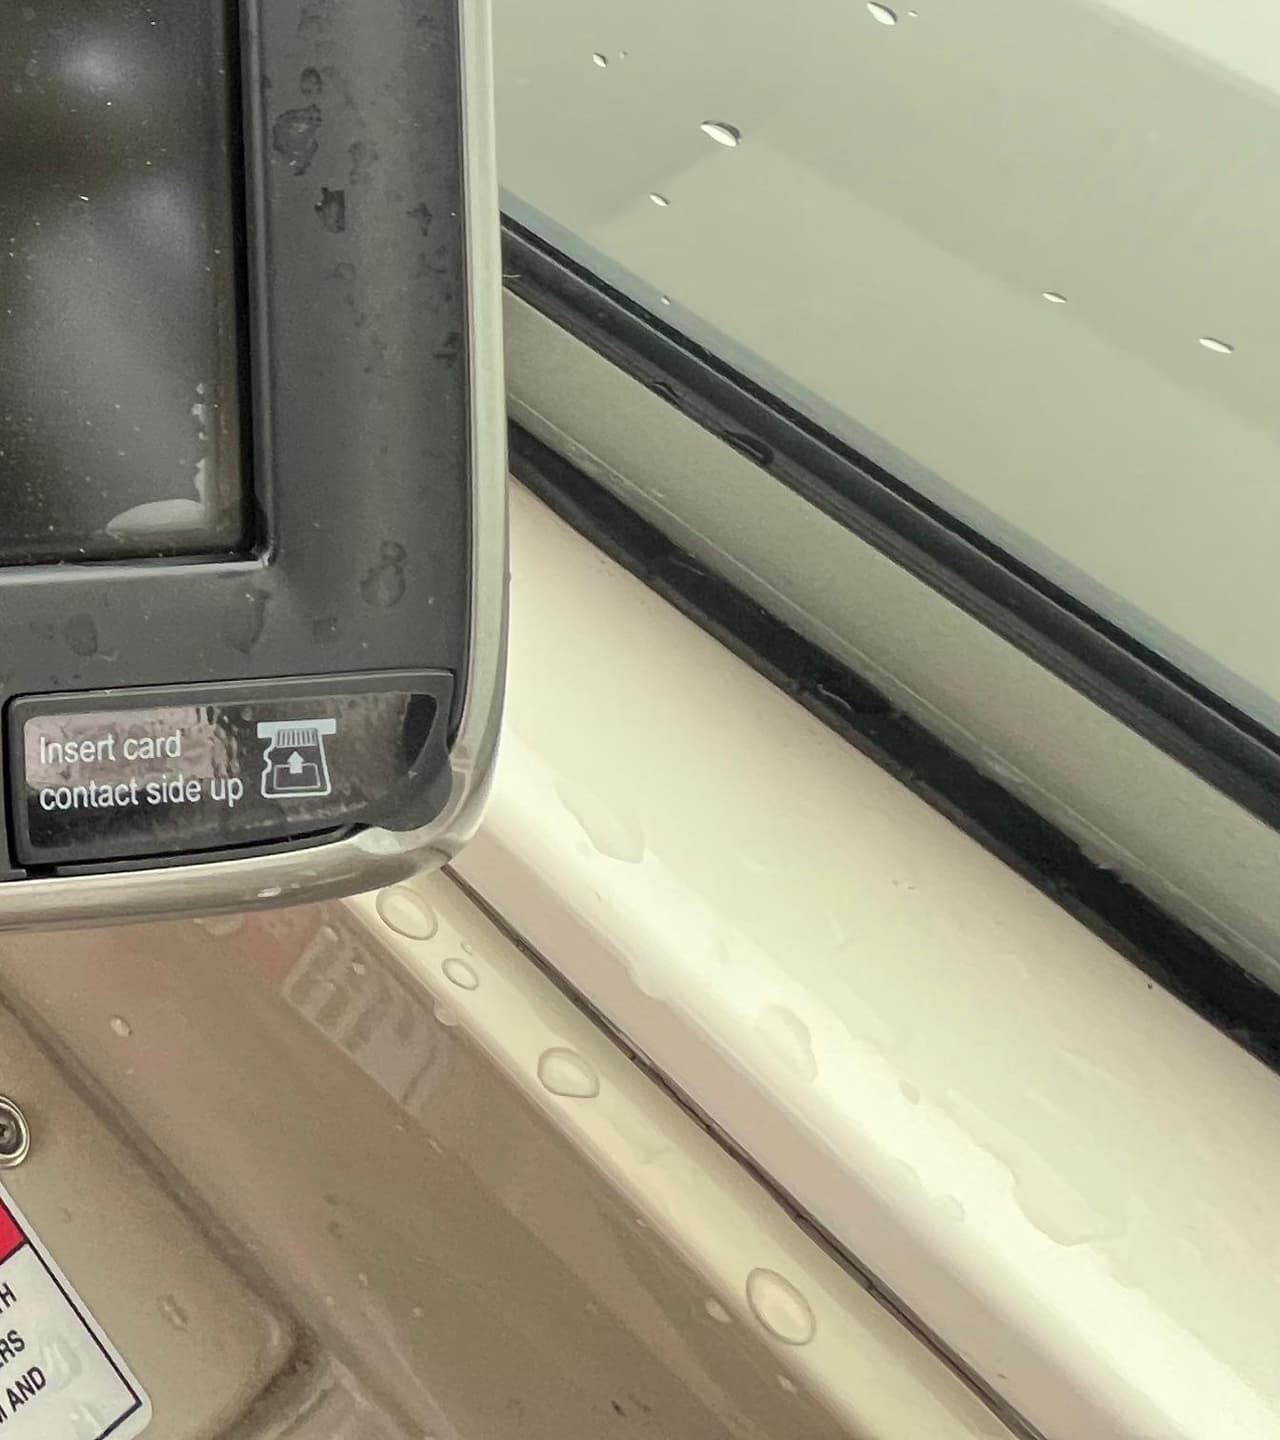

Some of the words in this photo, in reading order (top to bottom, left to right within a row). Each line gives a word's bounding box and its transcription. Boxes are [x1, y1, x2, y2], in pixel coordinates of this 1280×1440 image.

[40, 734, 114, 764] Insert
[124, 730, 182, 761] card
[40, 780, 139, 810] contact
[146, 775, 201, 805] side
[211, 777, 244, 807] up
[5, 1366, 47, 1412] AND
